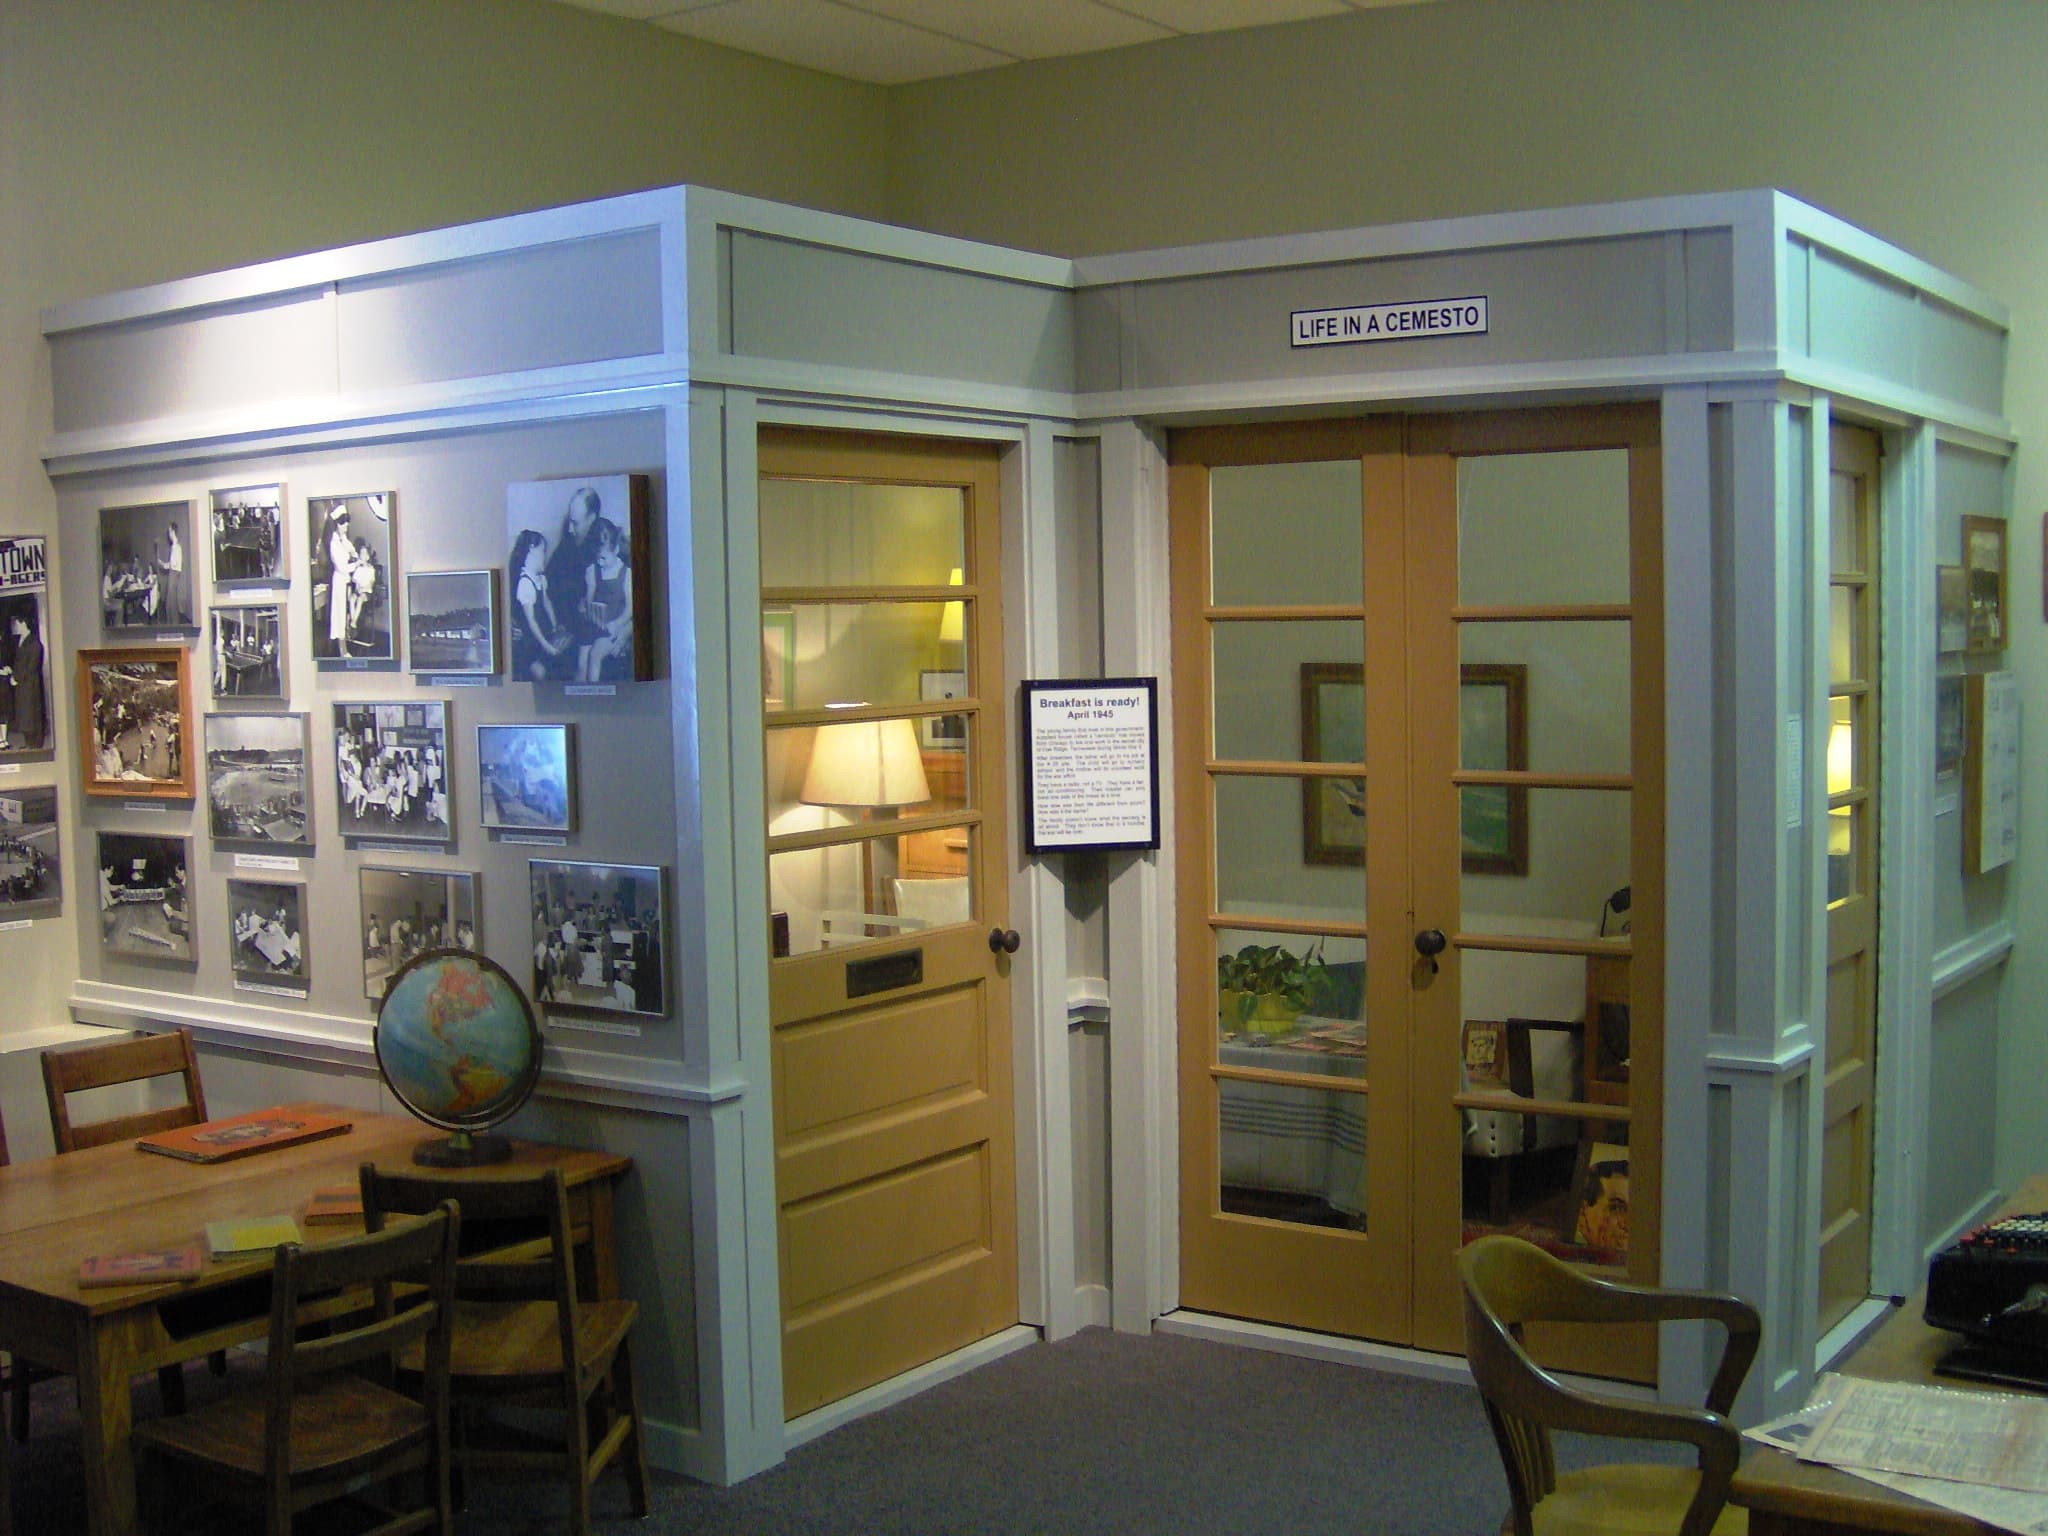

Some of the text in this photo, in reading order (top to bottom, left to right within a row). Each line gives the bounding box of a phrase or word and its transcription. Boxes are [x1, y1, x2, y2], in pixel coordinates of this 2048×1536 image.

[1299, 306, 1479, 339] LIFE IN A CEMESTO
[1040, 697, 1140, 709] Breakfast is ready!
[1067, 710, 1114, 720] April 1945
